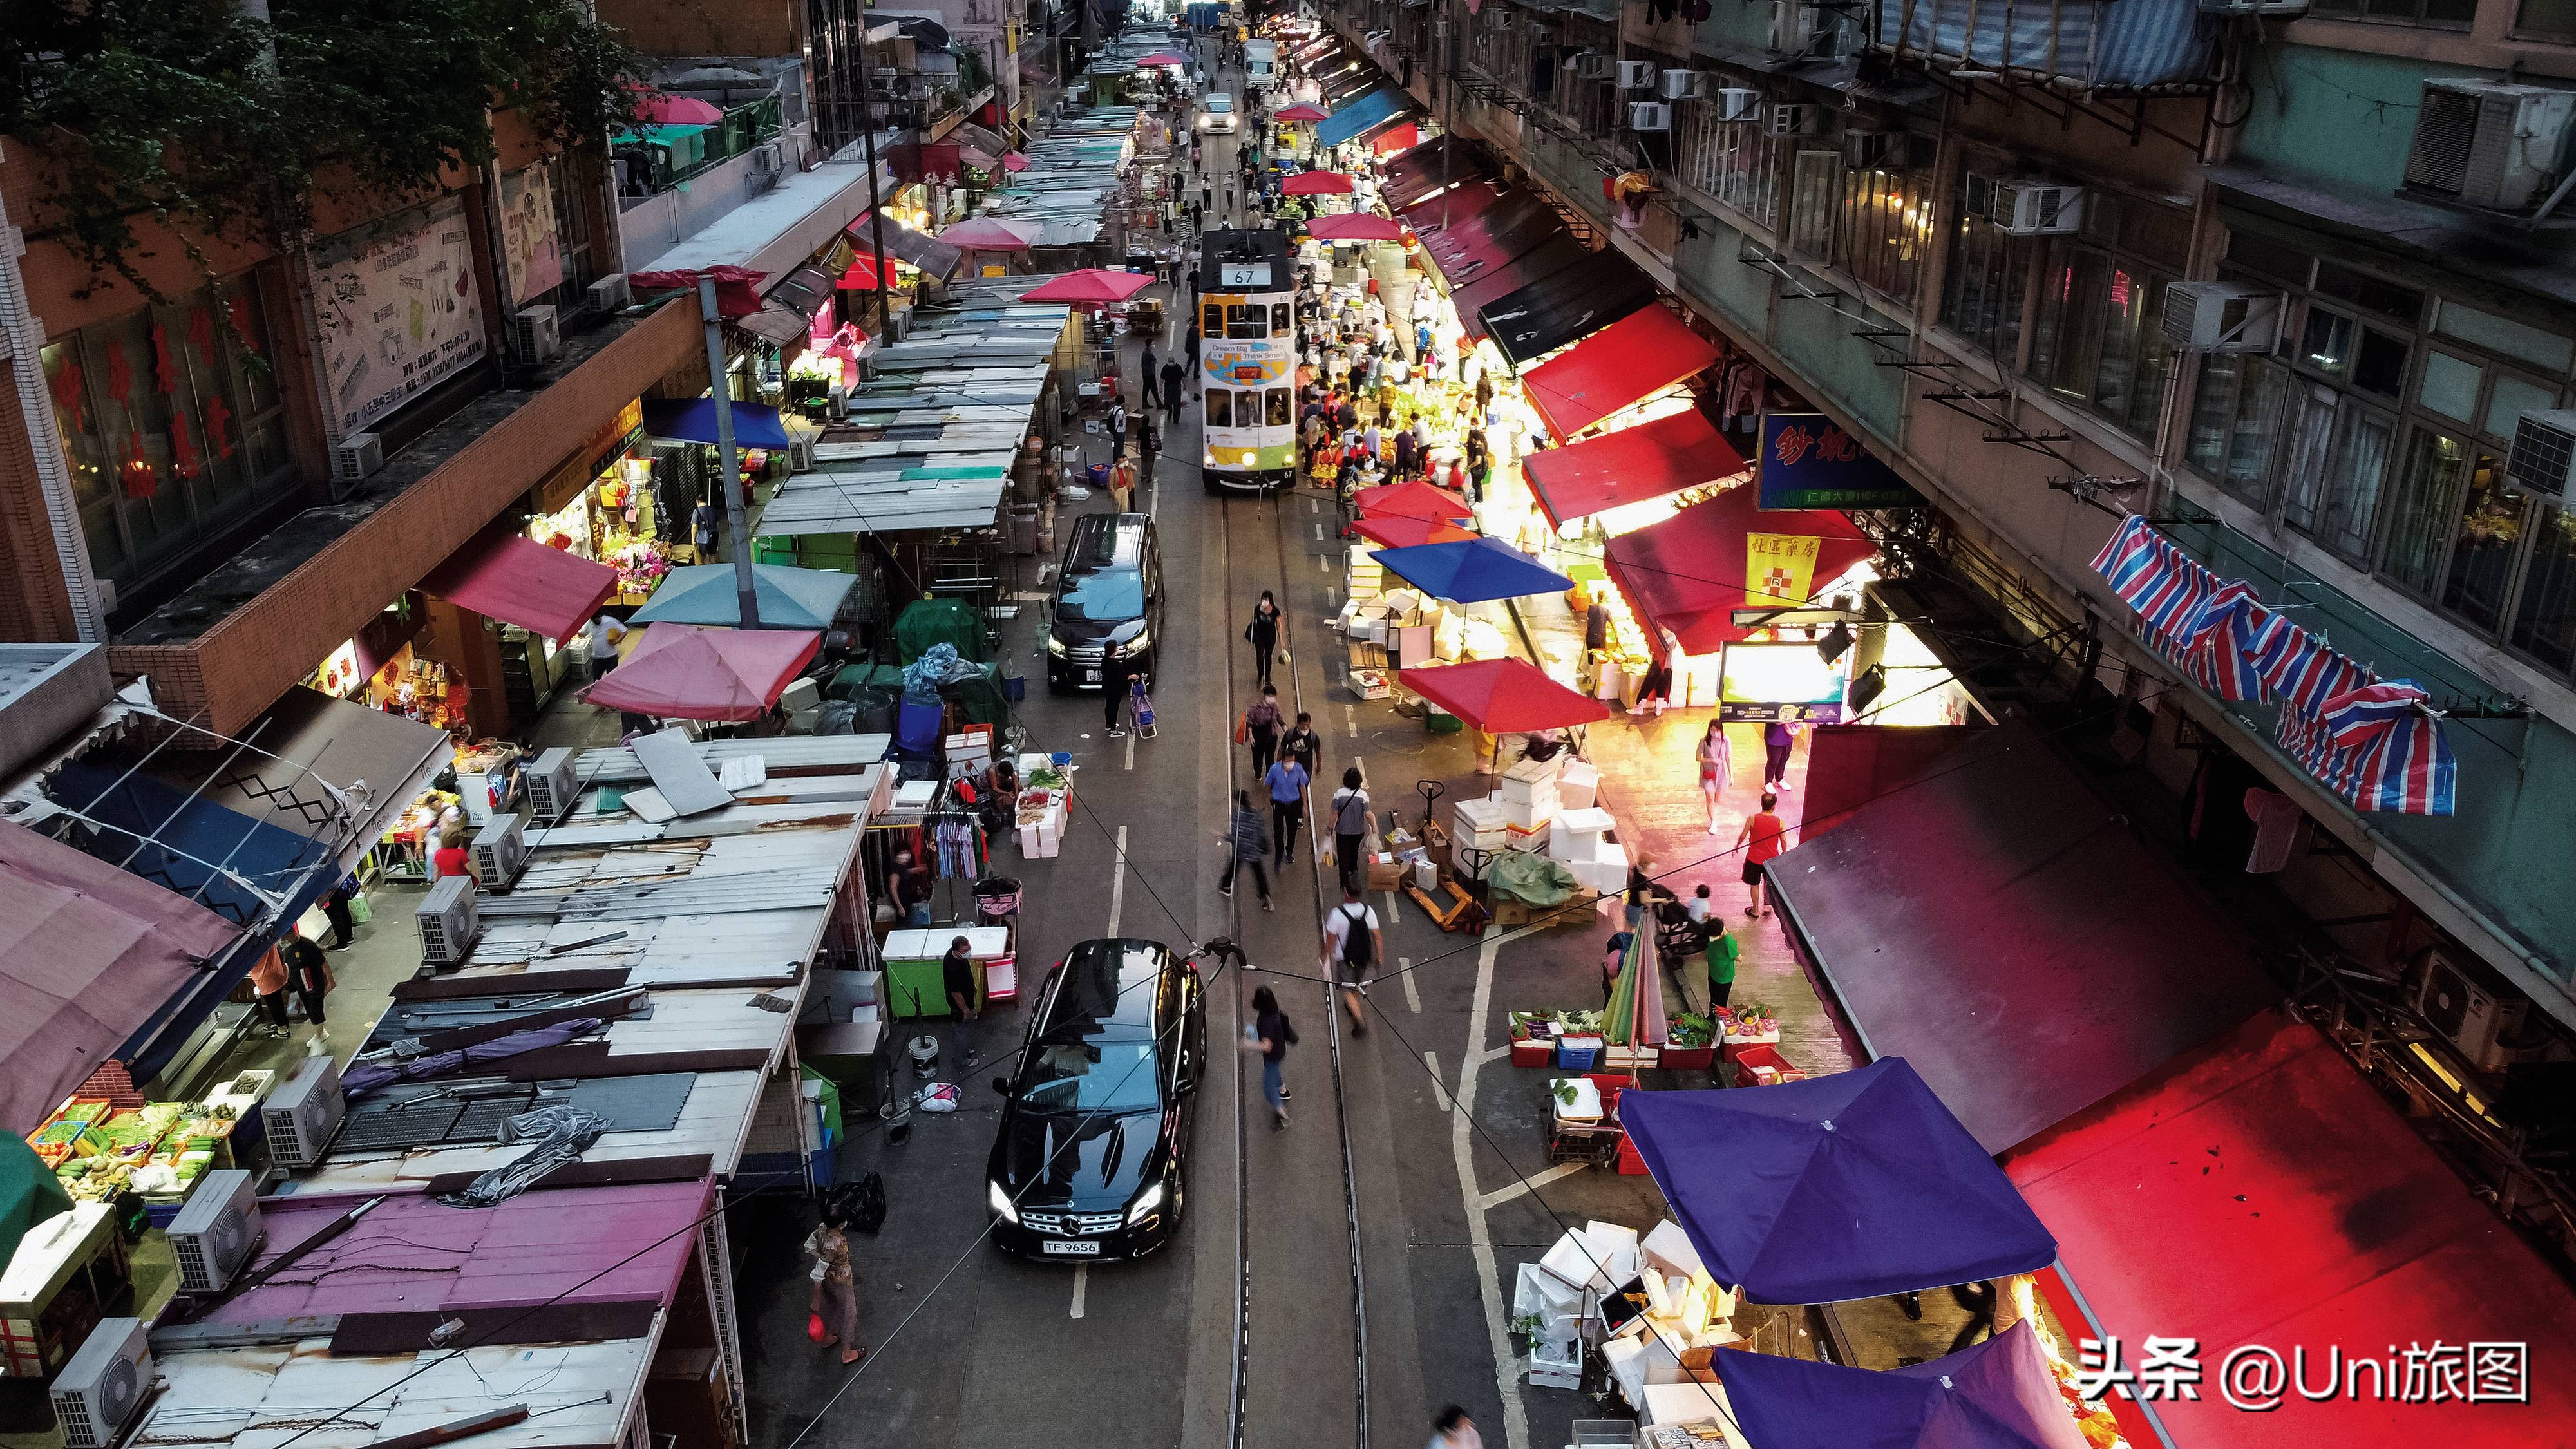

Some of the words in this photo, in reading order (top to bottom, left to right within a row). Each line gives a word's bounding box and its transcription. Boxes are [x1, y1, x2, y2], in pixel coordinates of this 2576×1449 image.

[1235, 270, 1254, 283] 67
[1284, 470, 1293, 478] 67
[1751, 538, 1815, 558] 社區藥房
[1046, 1242, 1061, 1251] TF
[1065, 1243, 1096, 1252] 9656
